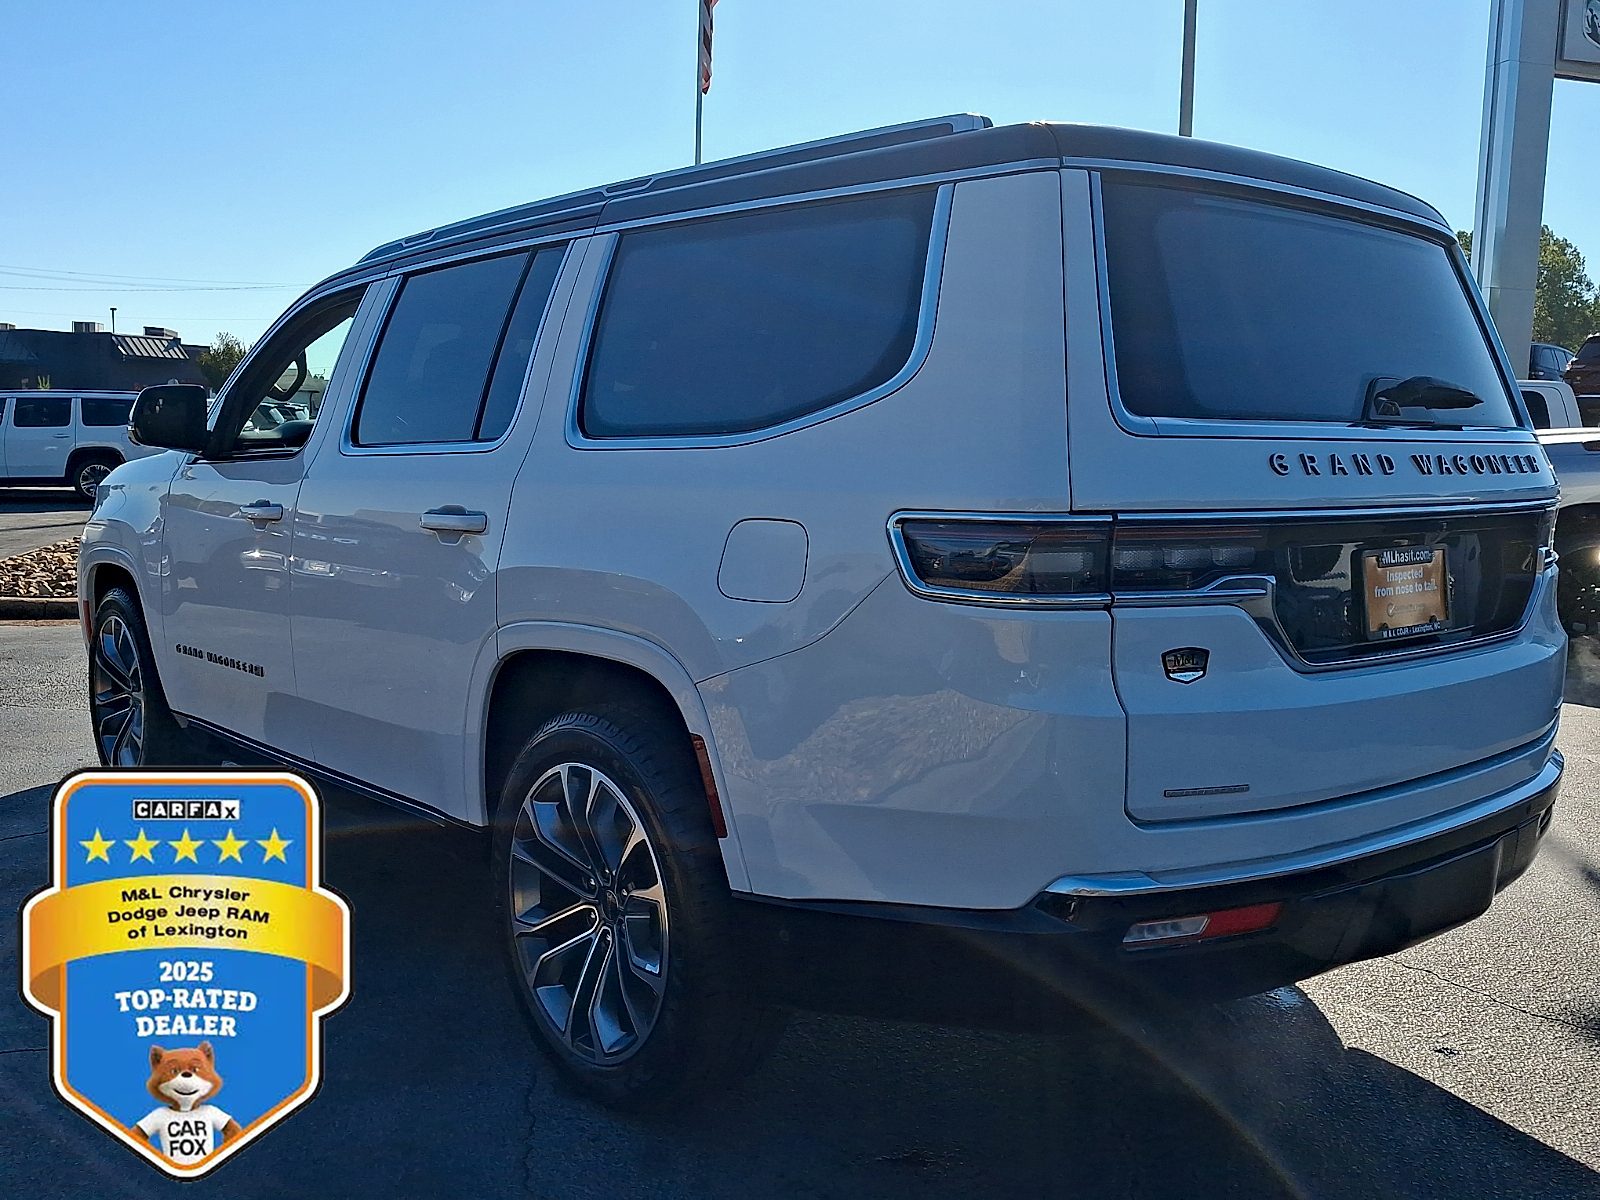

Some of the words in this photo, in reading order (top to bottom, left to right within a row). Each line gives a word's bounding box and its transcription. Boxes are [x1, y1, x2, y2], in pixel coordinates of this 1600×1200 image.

[1268, 452, 1396, 477] GRAND
[1410, 453, 1541, 475] WAGONEER
[1386, 566, 1424, 584] Inspected
[1374, 585, 1394, 598] from
[1395, 583, 1414, 595] nose
[1414, 581, 1423, 593] to
[175, 643, 204, 660] GRAND
[1173, 653, 1199, 667] M&L
